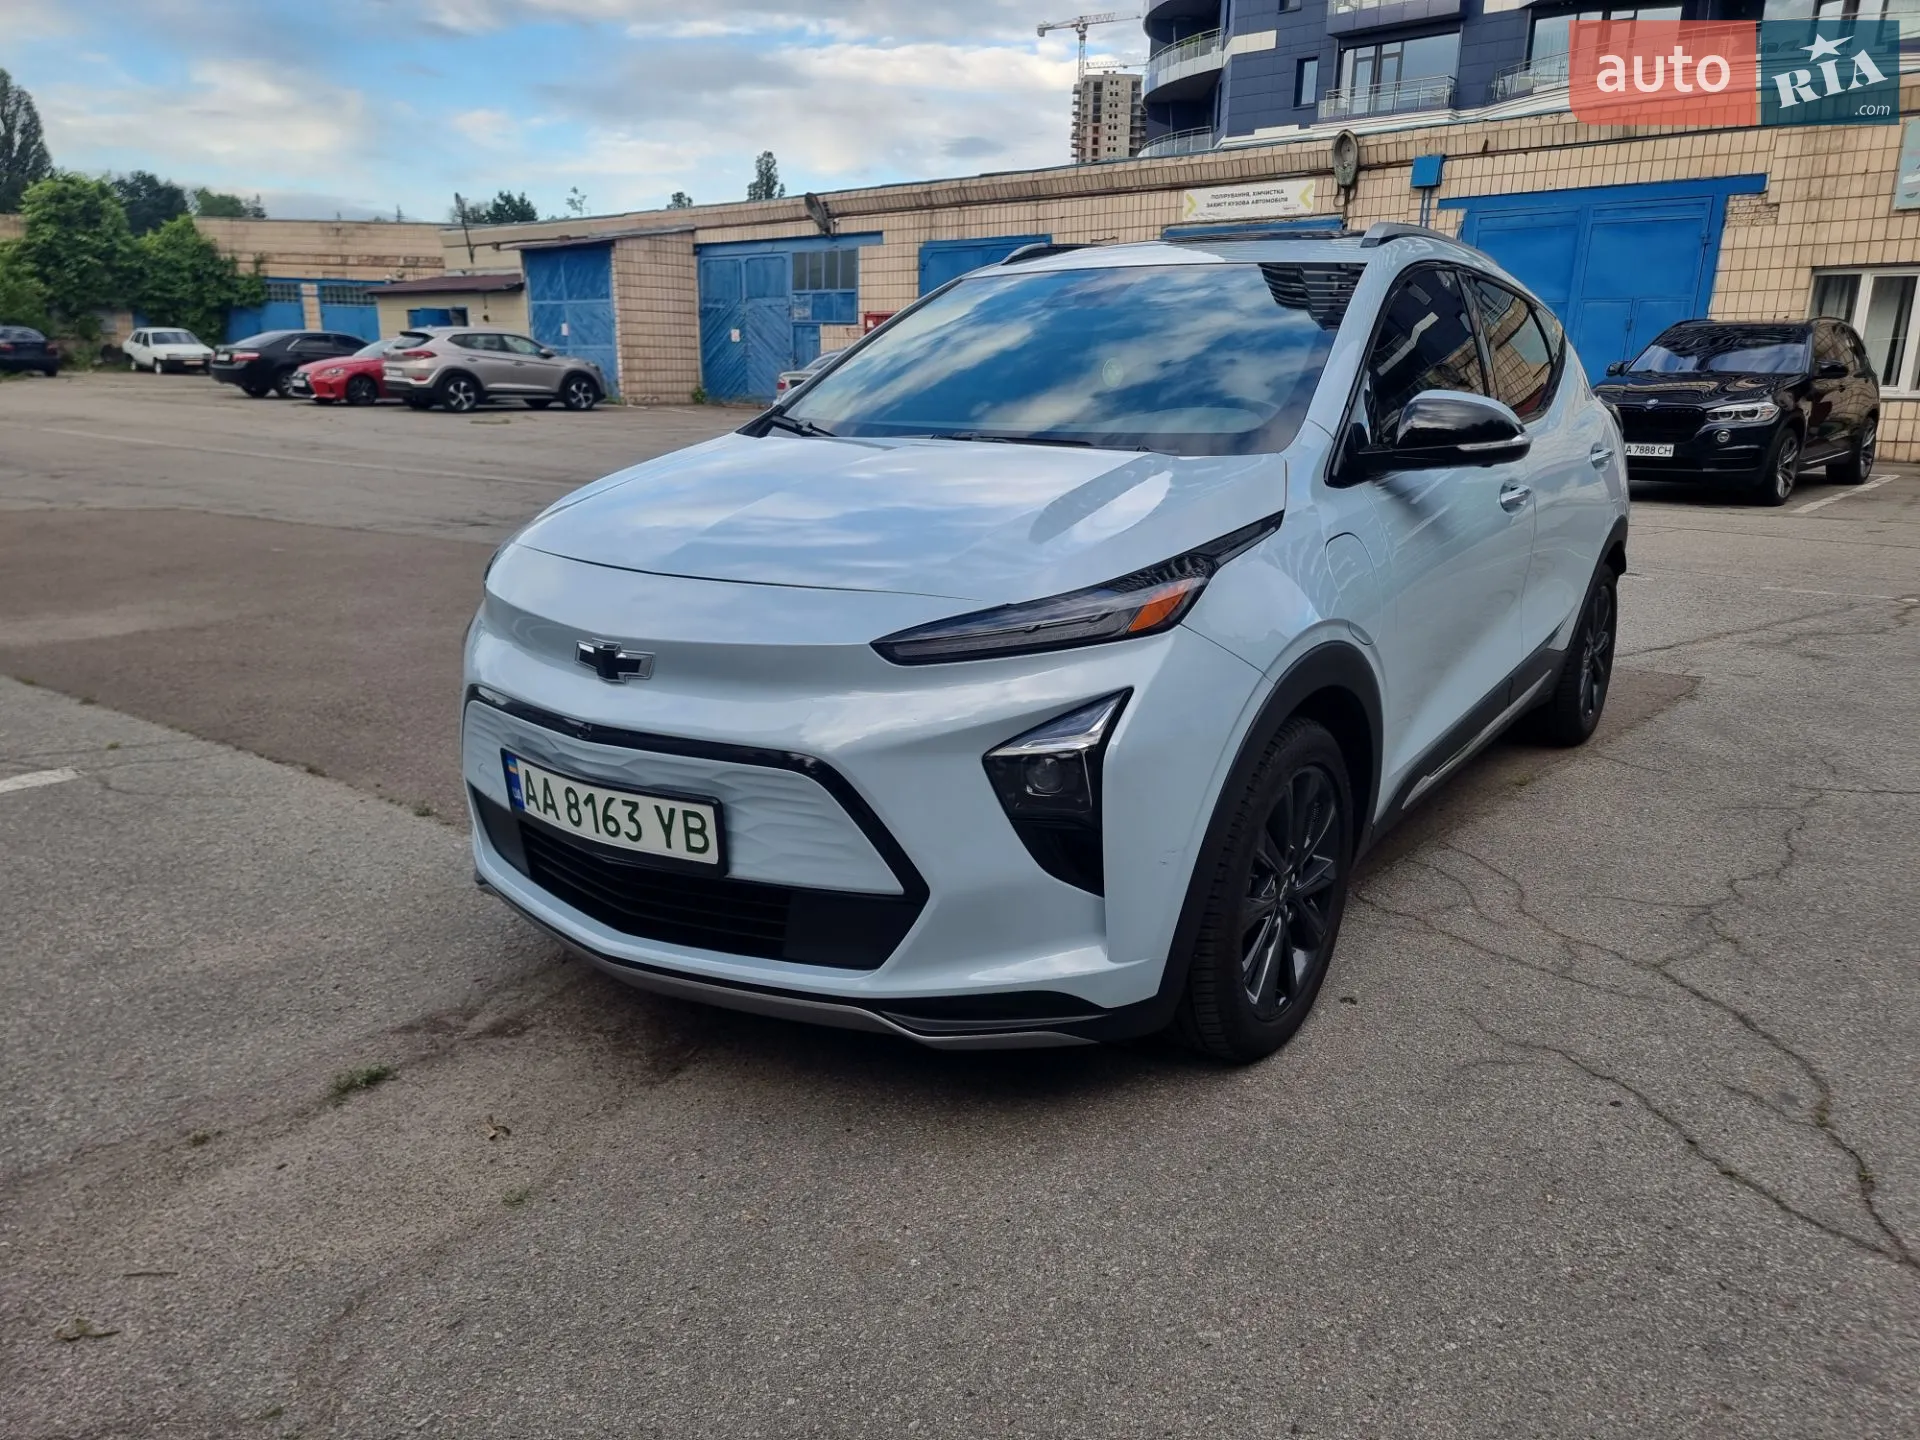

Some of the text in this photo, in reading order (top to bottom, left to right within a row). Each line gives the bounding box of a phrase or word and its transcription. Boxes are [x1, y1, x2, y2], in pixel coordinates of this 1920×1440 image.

[1634, 445, 1656, 455] 7888
[524, 769, 710, 855] AA 8163 YB
